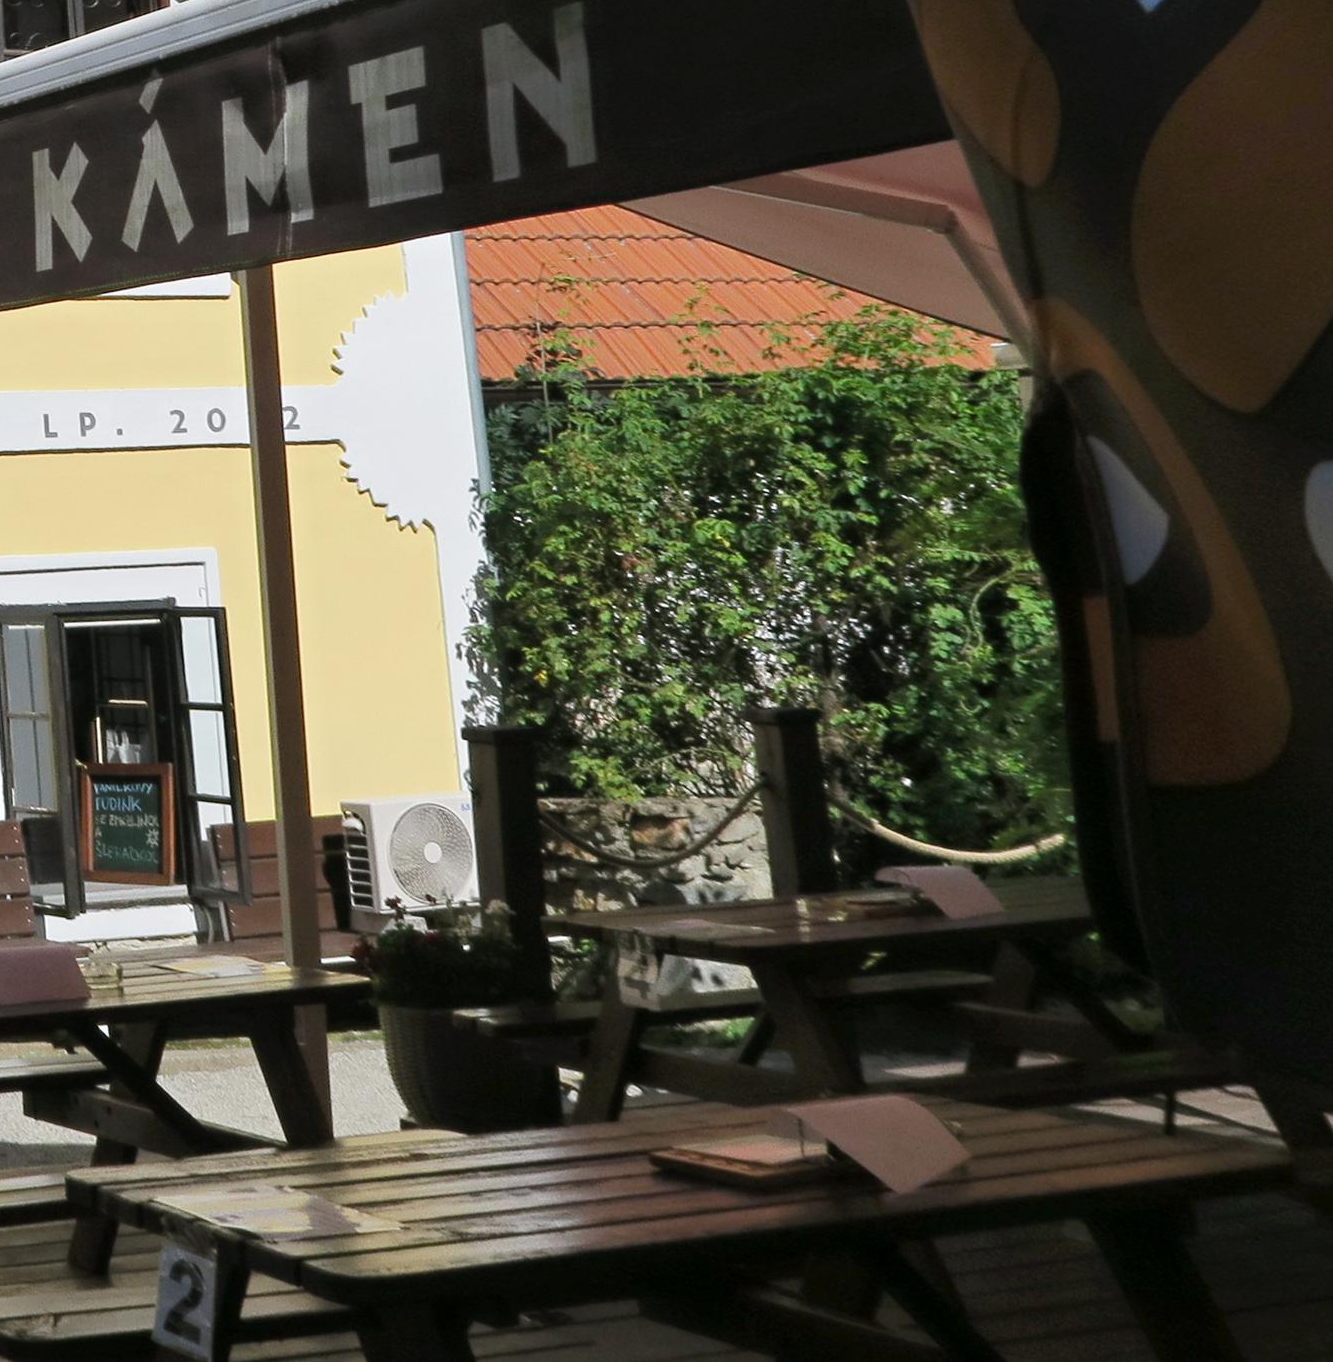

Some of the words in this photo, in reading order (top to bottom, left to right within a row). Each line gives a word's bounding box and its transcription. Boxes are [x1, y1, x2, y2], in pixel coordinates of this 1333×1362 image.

[31, 0, 599, 273] KÁMEN
[169, 404, 301, 435] 202
[162, 1258, 207, 1345] 2
